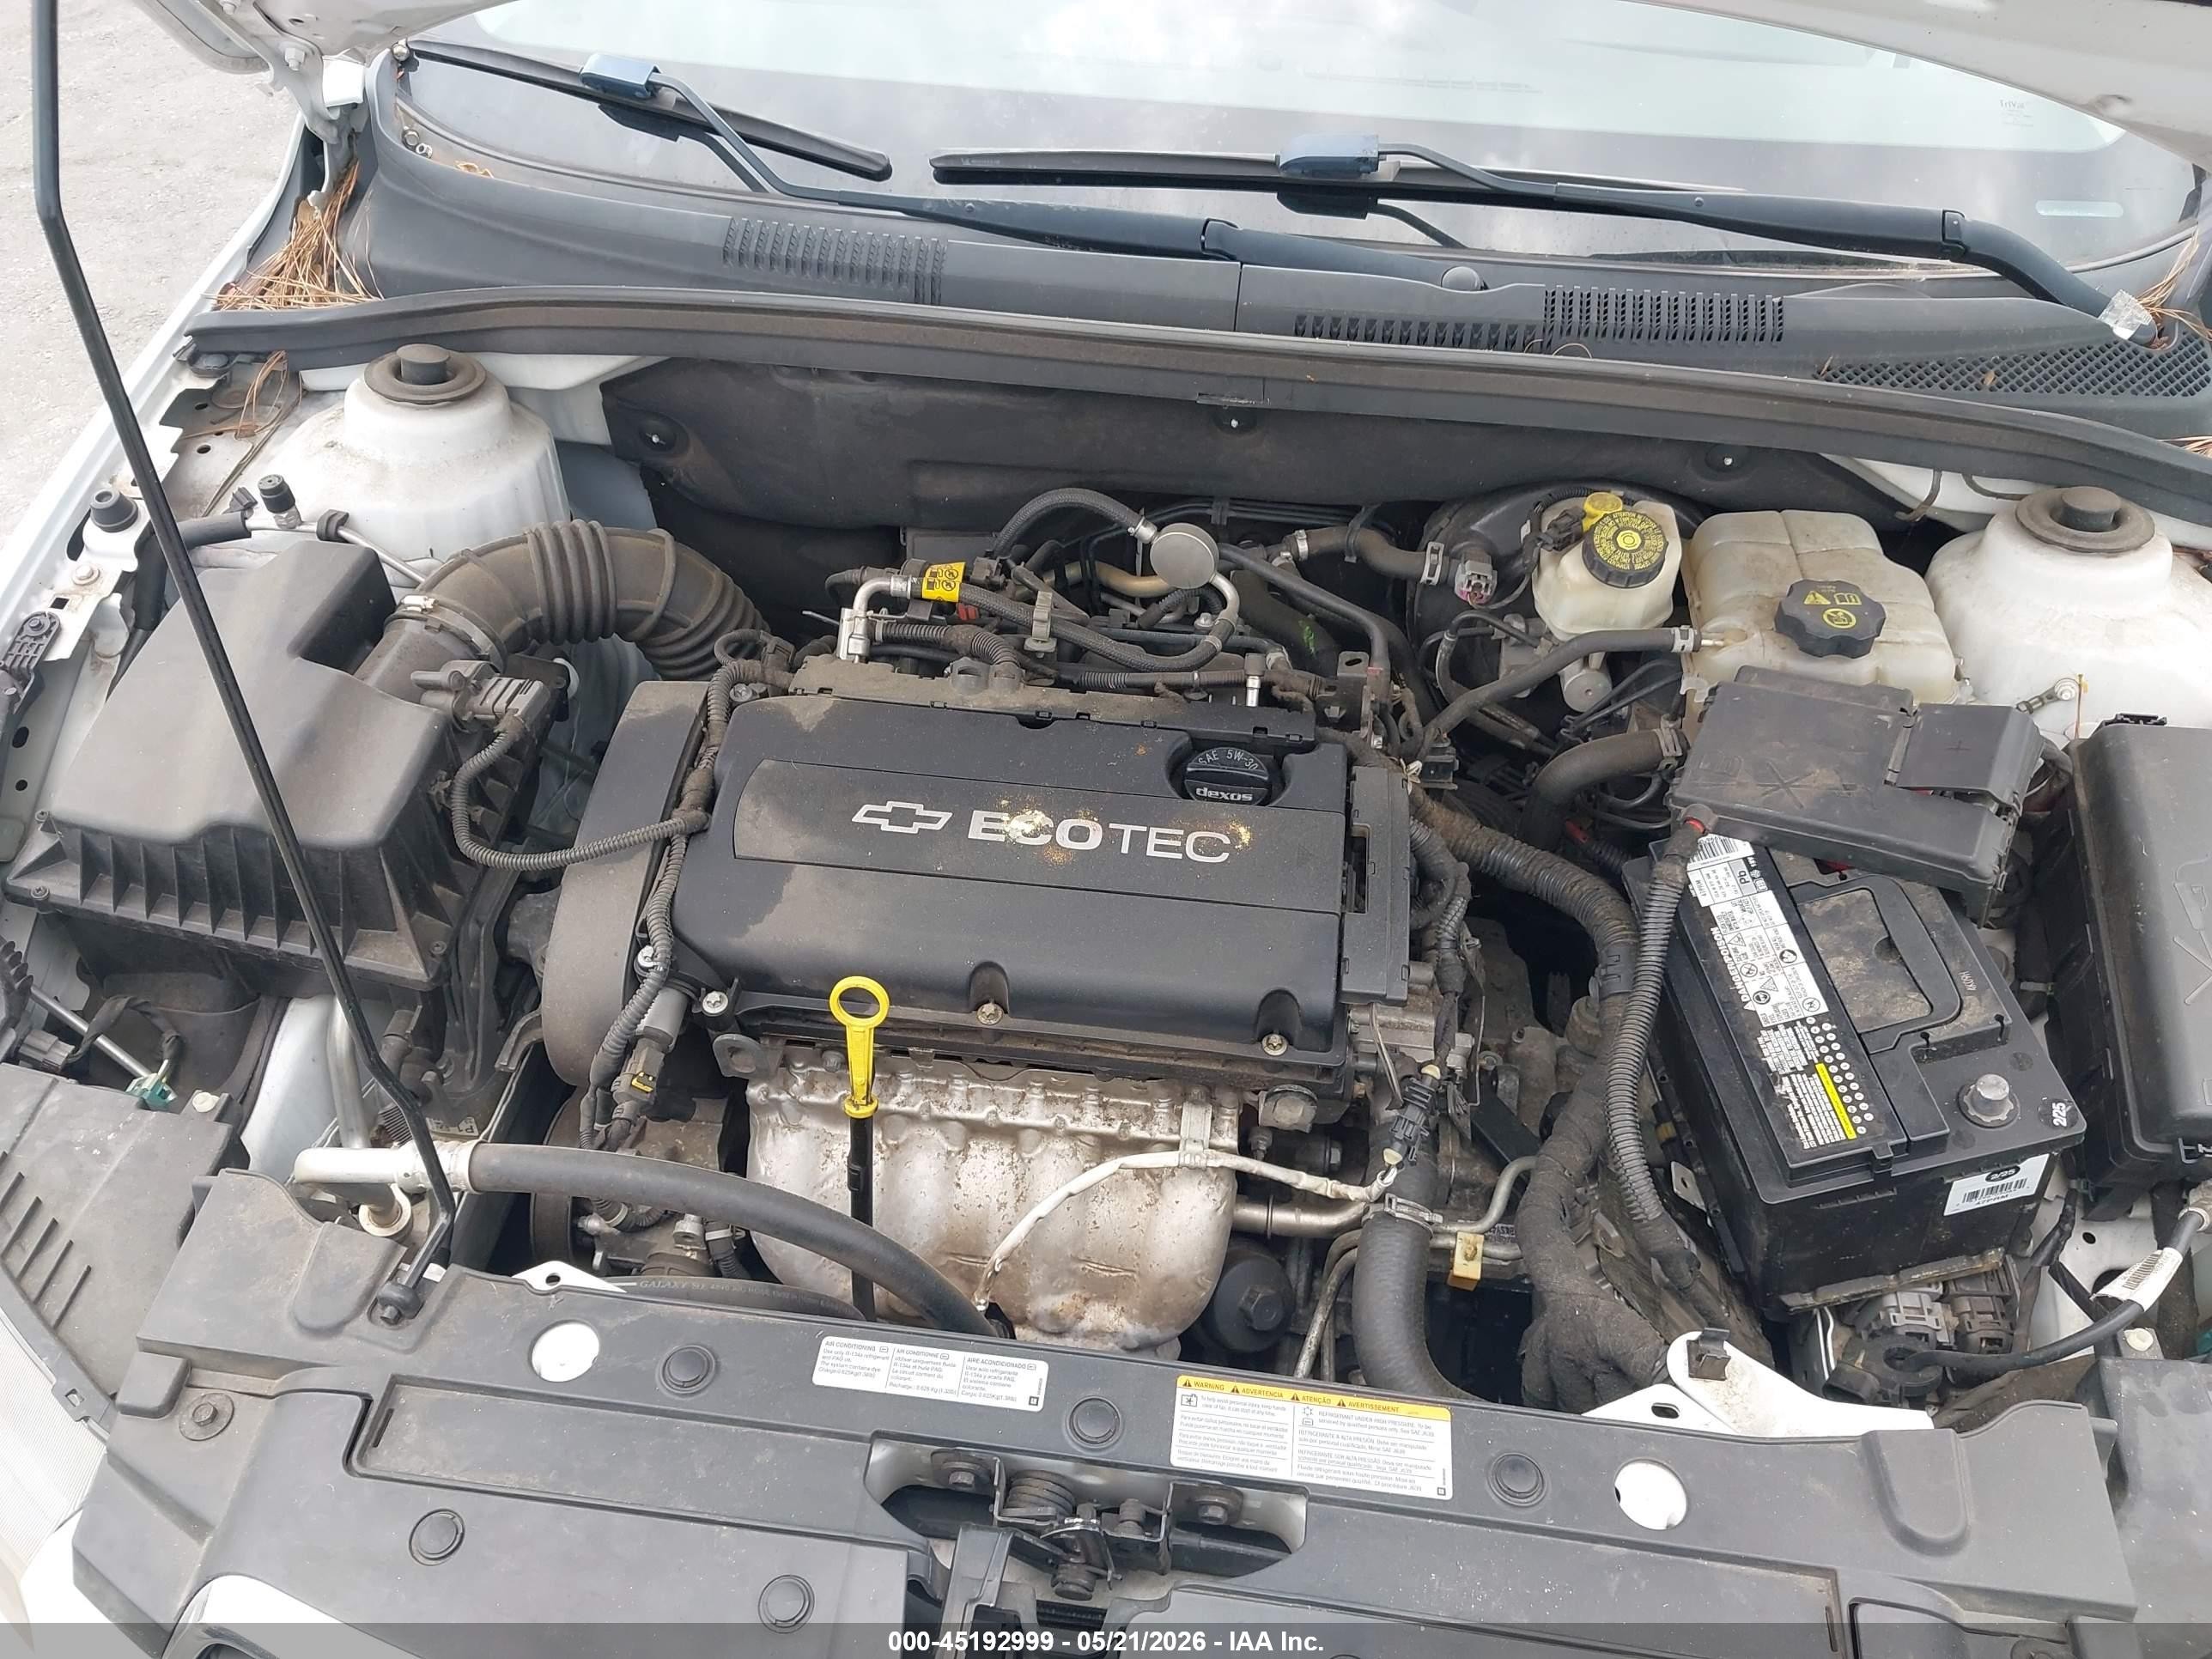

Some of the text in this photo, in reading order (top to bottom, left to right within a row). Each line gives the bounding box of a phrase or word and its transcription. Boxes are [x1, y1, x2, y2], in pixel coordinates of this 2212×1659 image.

[1198, 749, 1258, 770] SAE 5W-30
[1195, 787, 1253, 801] dexos
[968, 809, 1231, 863] ECOTEC
[1735, 869, 1750, 884] Pb
[1710, 927, 1747, 1002] DANGER/POISON
[2051, 1102, 2067, 1127] 2/25
[835, 1340, 876, 1352] CONDITIONING
[980, 1358, 1027, 1370] ACONDICIONADO
[1194, 1380, 1224, 1390] WARNING
[1241, 1387, 1284, 1398] ADVERTENCIA
[1301, 1394, 1331, 1406] ATENÇÃO
[1347, 1401, 1400, 1413] AVERTISSEMENT
